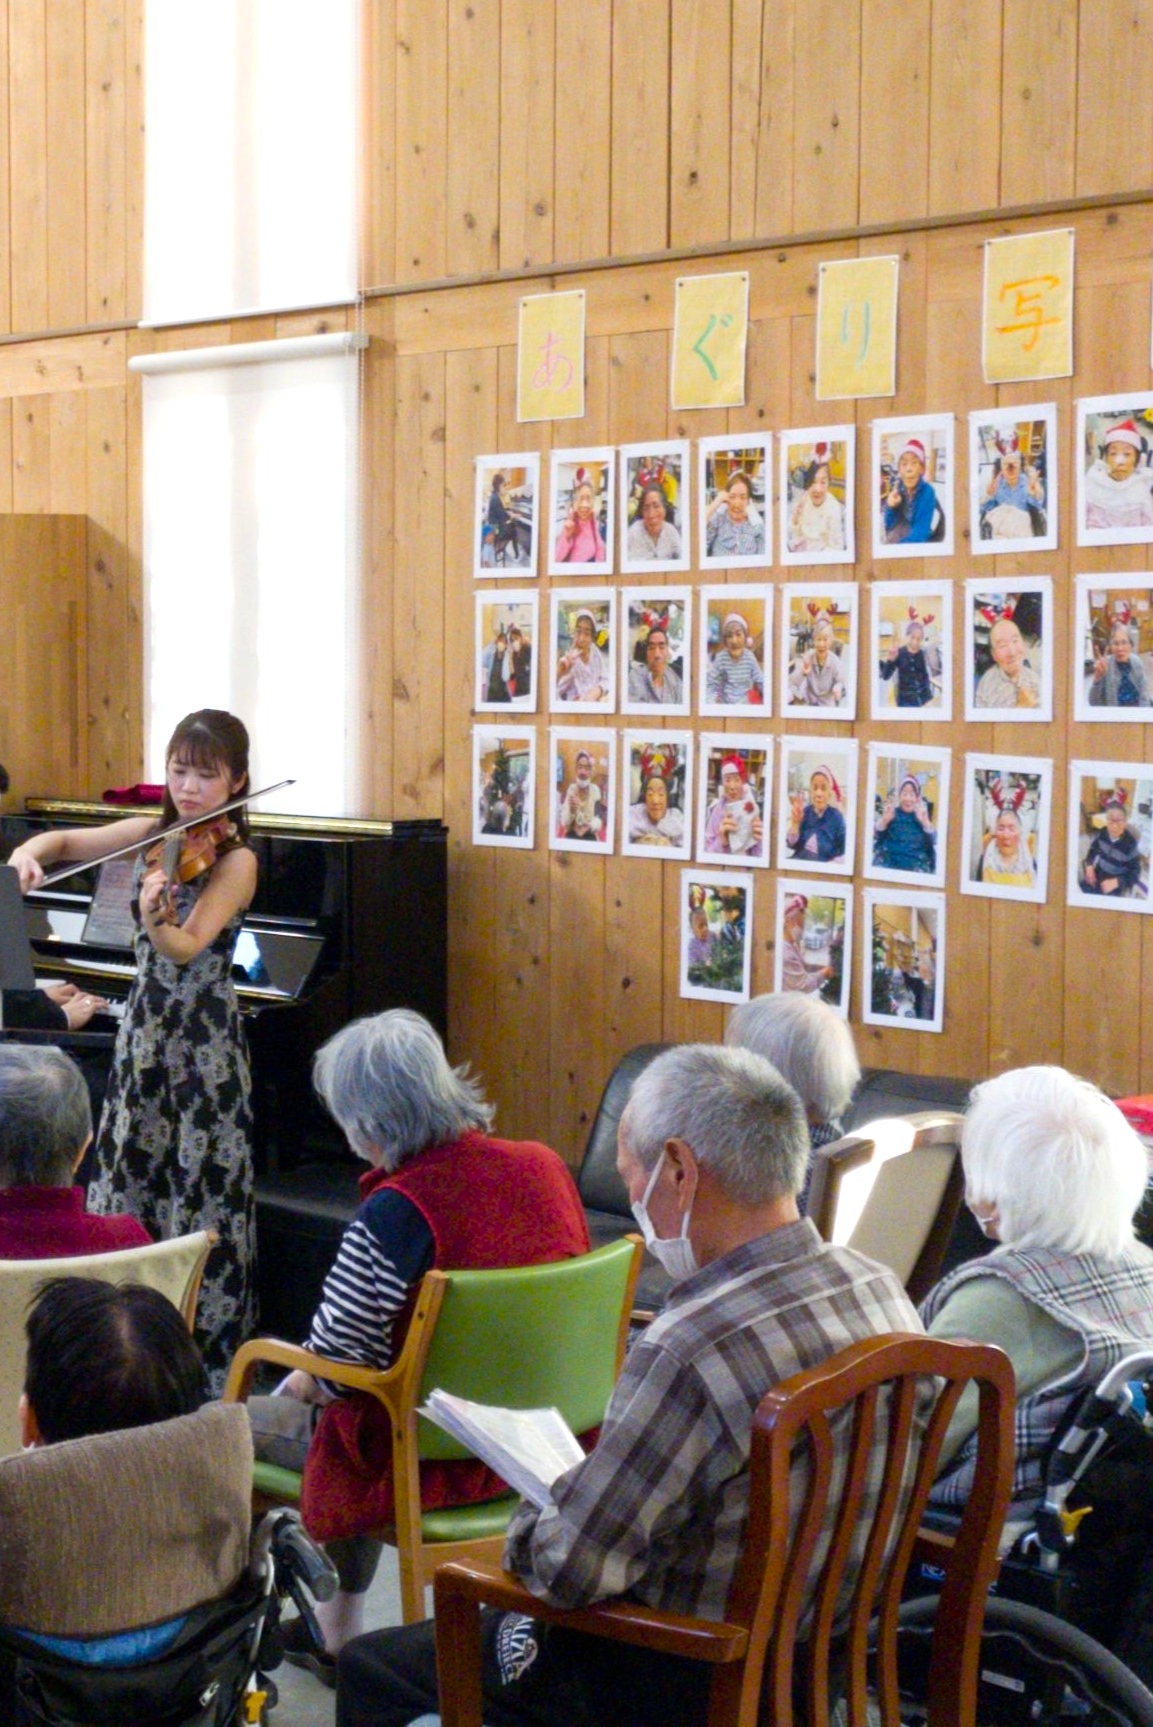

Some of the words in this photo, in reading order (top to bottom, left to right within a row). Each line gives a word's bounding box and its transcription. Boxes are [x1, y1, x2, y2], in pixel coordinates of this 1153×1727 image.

[532, 331, 573, 393] あ
[693, 314, 734, 381] ぐ
[996, 274, 1061, 352] 写
